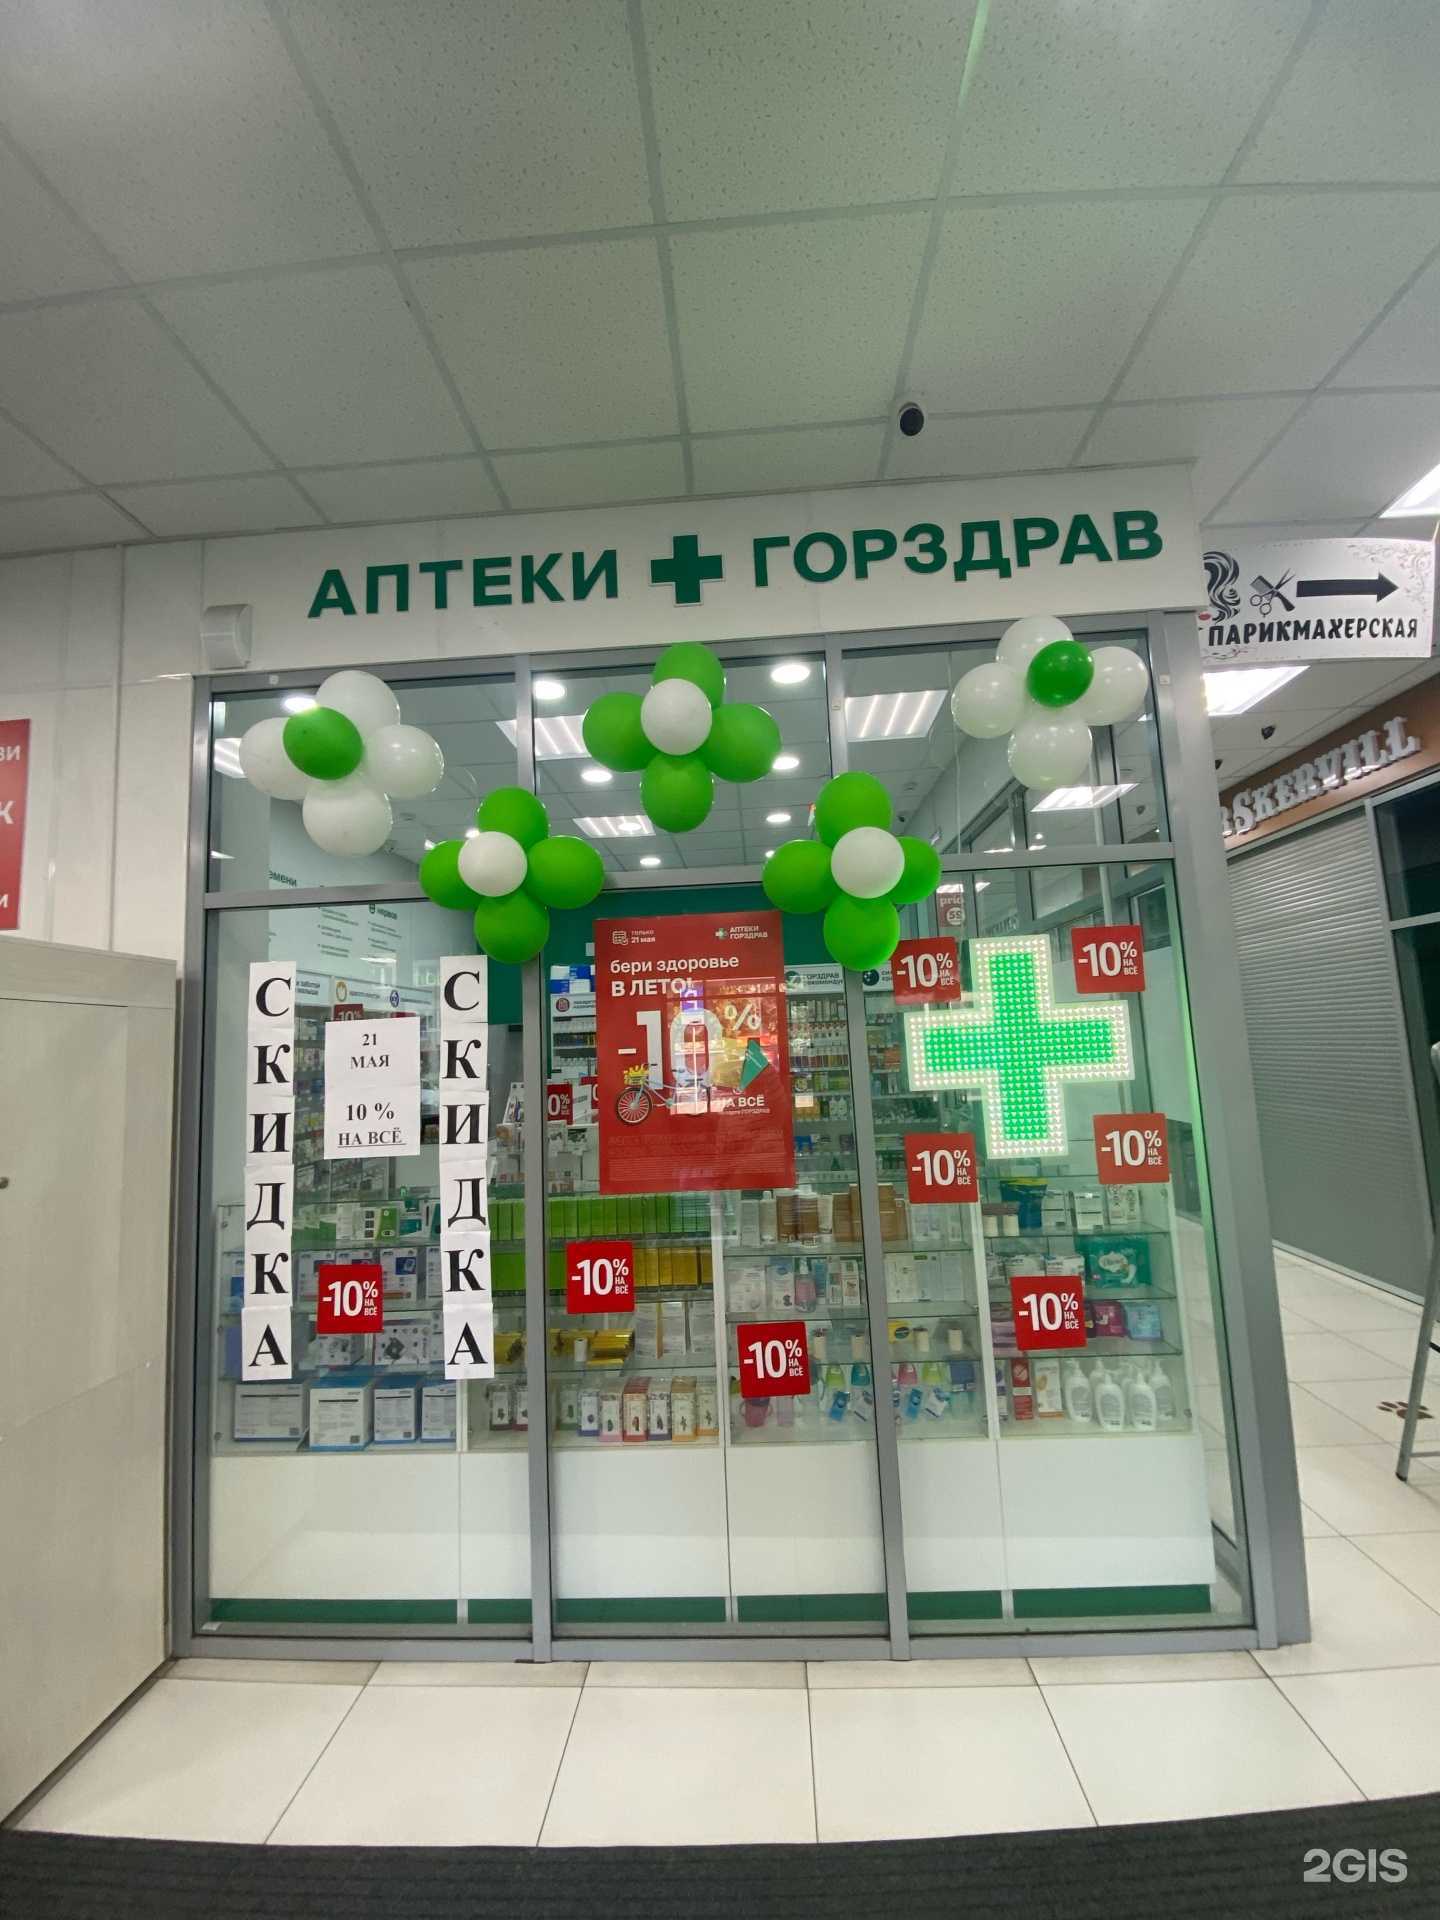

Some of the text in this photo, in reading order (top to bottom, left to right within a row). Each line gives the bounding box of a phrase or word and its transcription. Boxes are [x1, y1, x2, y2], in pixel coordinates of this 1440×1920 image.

[307, 510, 1164, 619] АПТЕКИ ГОРЗДРАВ
[1208, 617, 1418, 646] ПАРИКМАХЕРСКАЯ
[730, 925, 760, 933] АПТЕКИ
[730, 931, 769, 940] ГОРЗДРАВ
[610, 956, 740, 975] бери здоровье
[611, 980, 626, 997] В
[362, 1033, 377, 1046] 21
[350, 1054, 391, 1069] МАЯ
[338, 1127, 403, 1146] НА ВСЁ
